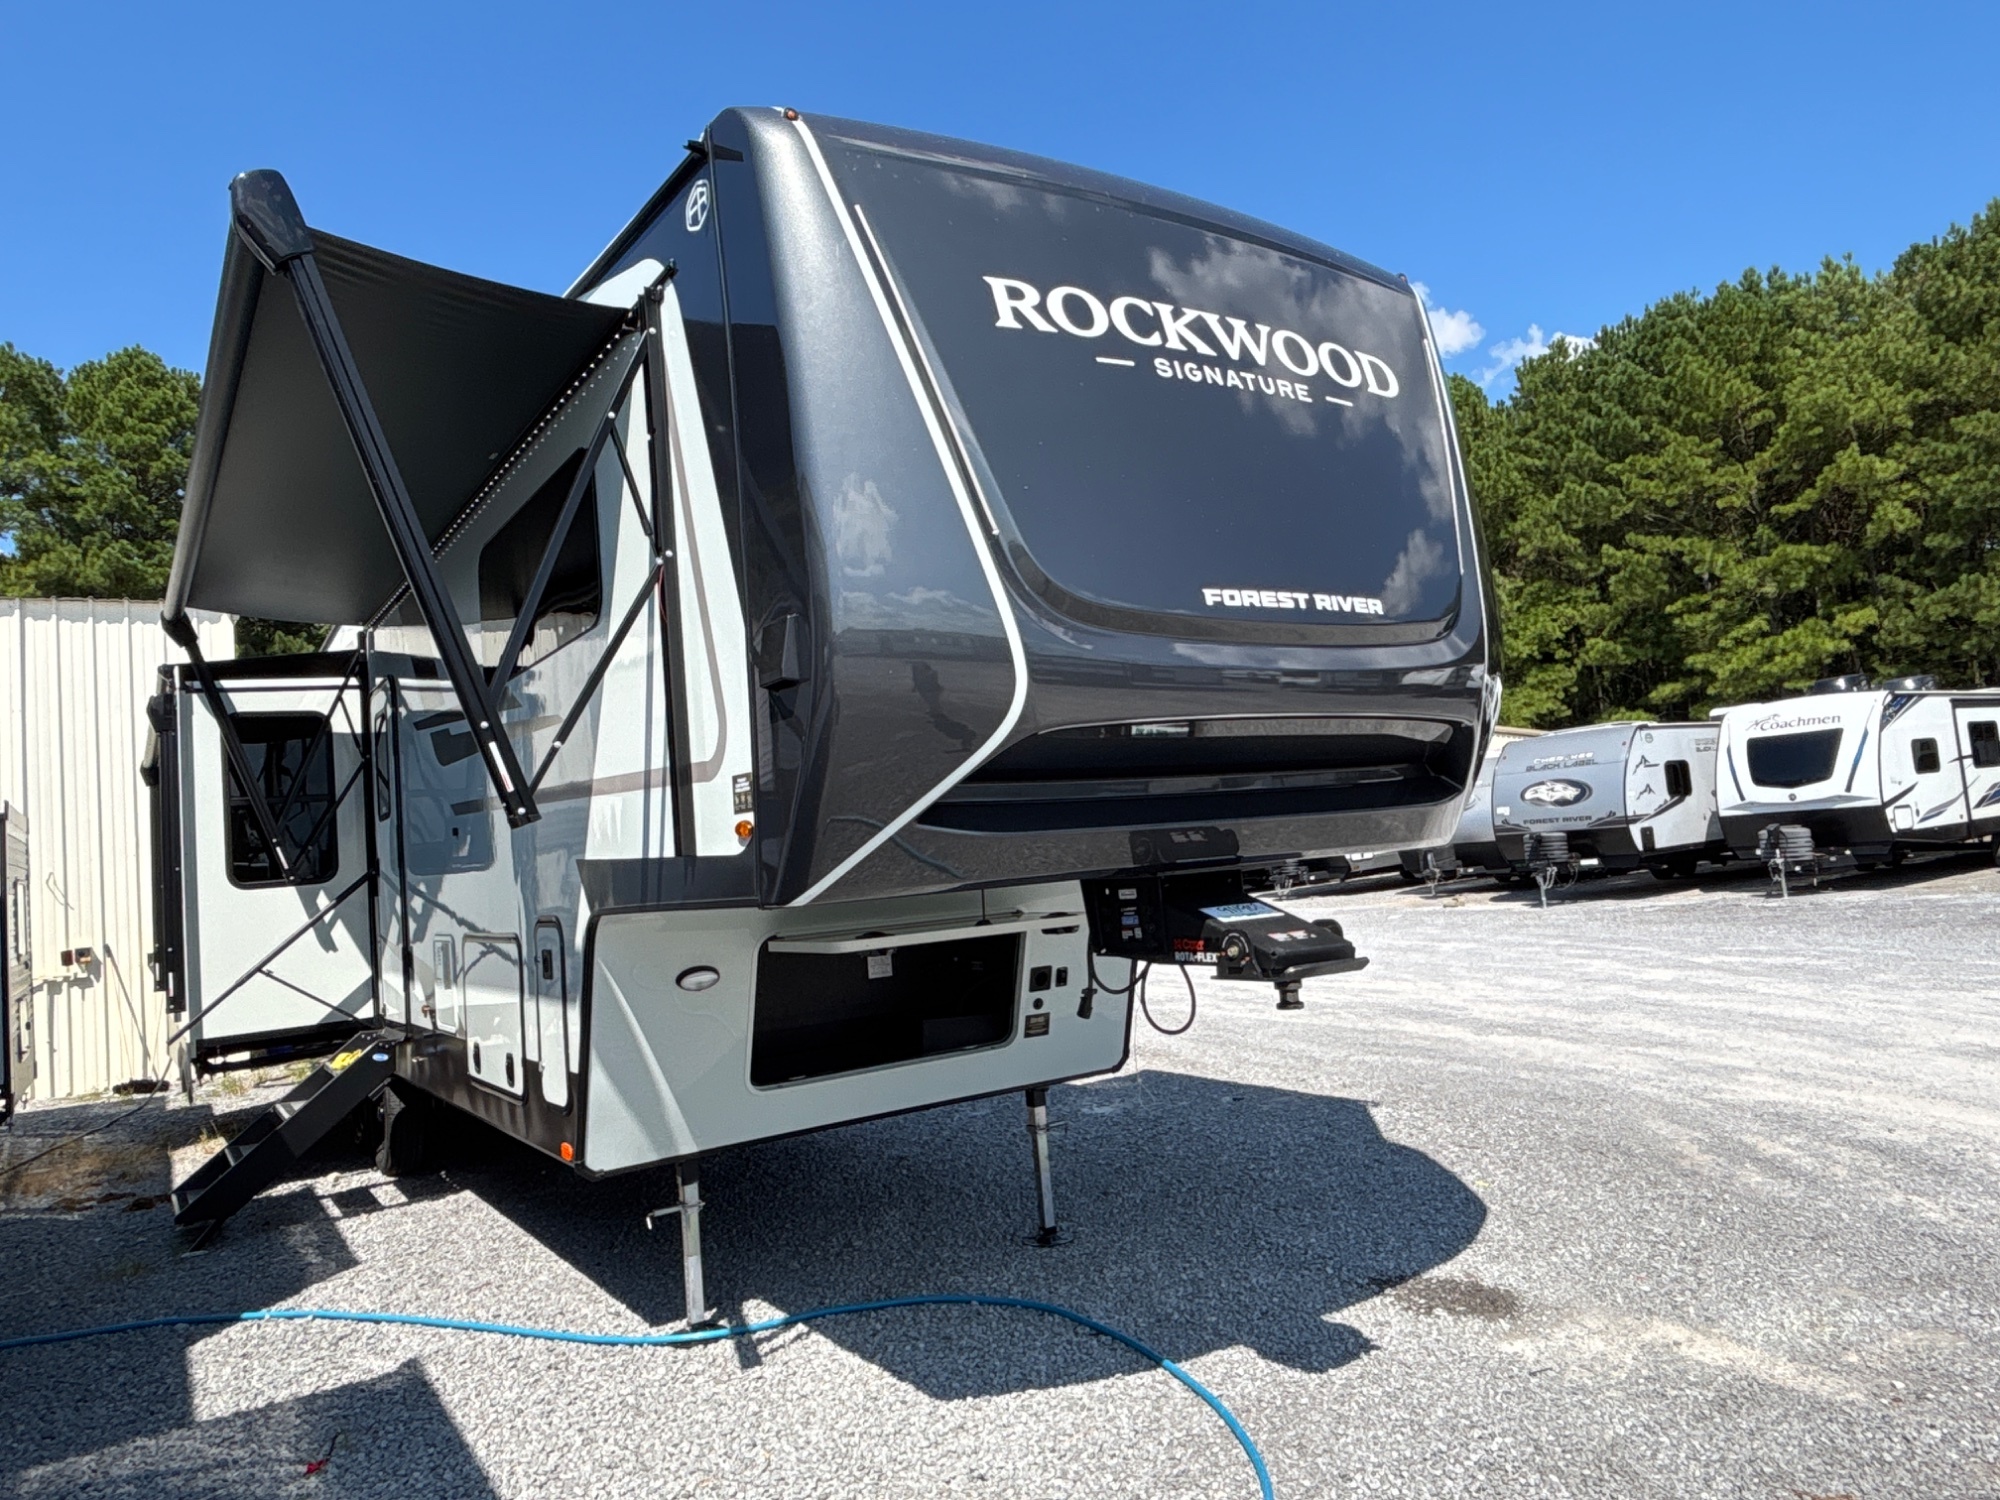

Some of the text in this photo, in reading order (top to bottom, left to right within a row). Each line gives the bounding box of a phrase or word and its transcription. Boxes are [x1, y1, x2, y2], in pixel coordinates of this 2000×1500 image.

[982, 276, 1400, 398] ROCKWOOD
[1153, 357, 1314, 403] SIGNATURE
[1202, 588, 1385, 615] FOREST RIVER
[1760, 715, 1841, 731] Coachmen
[1564, 758, 1598, 769] LABEL
[1523, 815, 1592, 825] FOREST RIVER
